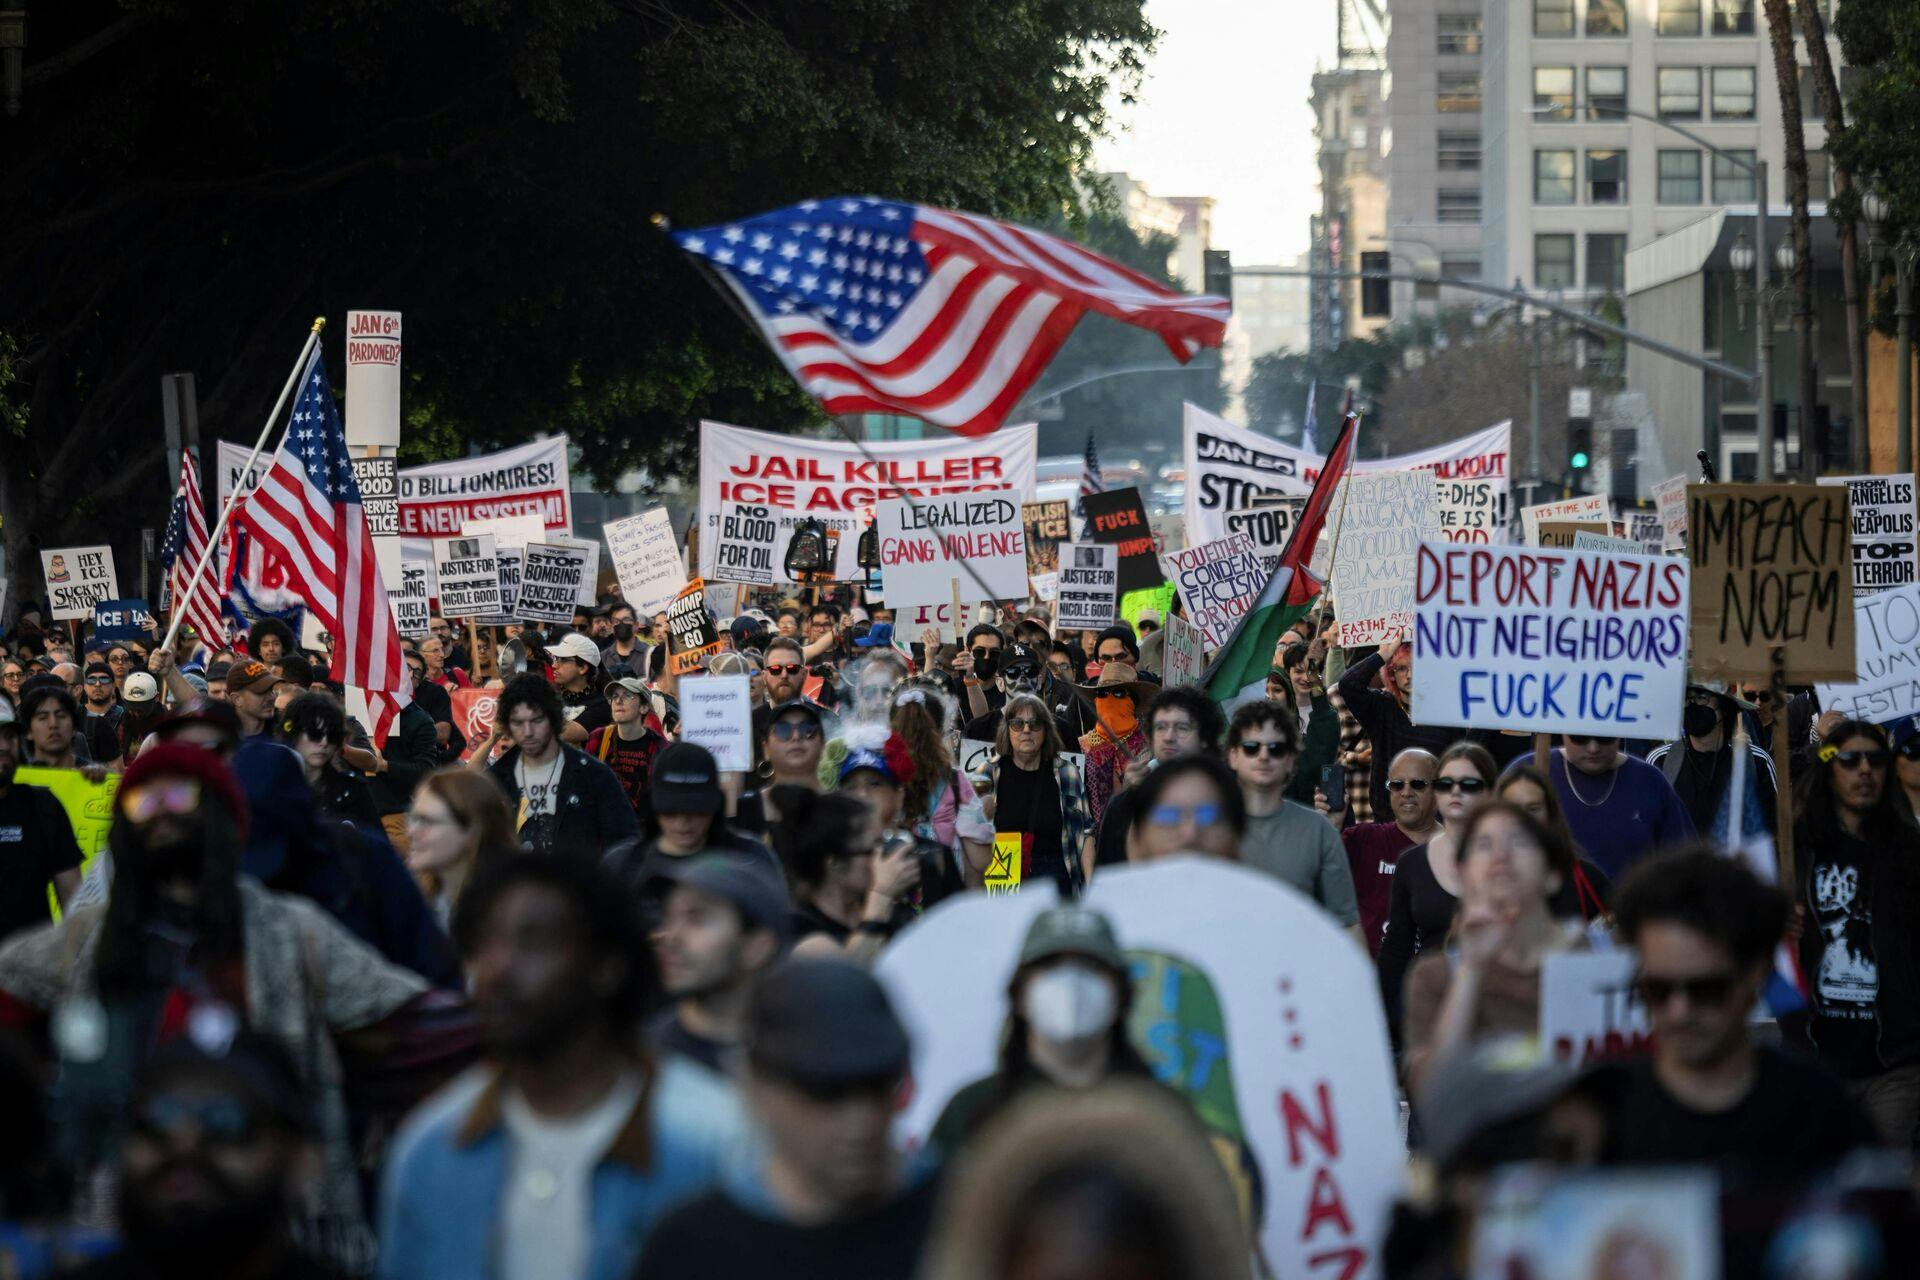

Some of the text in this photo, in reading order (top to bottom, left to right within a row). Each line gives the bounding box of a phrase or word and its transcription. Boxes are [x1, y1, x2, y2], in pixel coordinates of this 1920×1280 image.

[351, 314, 399, 335] JAN 6th
[349, 342, 401, 362] PARDONED?
[1198, 440, 1253, 465] JAN
[1256, 456, 1295, 475] 20
[1431, 453, 1506, 479] ALKOUT
[353, 461, 394, 480] RENEE
[418, 462, 555, 497] BILLIONAIRES!
[729, 455, 1003, 484] JAIL KILLER
[1846, 481, 1887, 489] FROM
[1851, 483, 1912, 505] ANGELES
[720, 482, 796, 510] ICE
[362, 500, 399, 515] SERVES
[735, 504, 769, 518] NO
[901, 499, 1016, 531] LEGALIZED
[1024, 504, 1067, 523] BOLISH
[1535, 500, 1601, 519] IT'S TIME WE
[1858, 508, 1878, 516] TO
[366, 515, 399, 531] TICE
[421, 505, 468, 533] NEW
[1038, 520, 1067, 538] ICE
[1095, 510, 1140, 533] FUCK
[1228, 510, 1289, 547] STOP
[1464, 511, 1486, 528] IS
[1851, 514, 1913, 535] NEAPOLIS
[723, 517, 776, 543] BLOOD
[1693, 494, 1849, 570] IMPEACH
[881, 531, 1024, 565] GANG VIOLENCE
[1117, 537, 1155, 557] UMP!
[1577, 535, 1609, 550] NORTH
[1852, 543, 1914, 560] TOP
[78, 552, 103, 567] HEY
[527, 554, 584, 567] STOP
[719, 544, 773, 570] FOR OIL
[1170, 547, 1206, 571] YOU
[81, 566, 110, 580] ICE.
[440, 559, 495, 576] JUSTICE FOR
[524, 564, 580, 585] BOMBING
[1061, 569, 1115, 585] JUSTICE FOR
[1180, 552, 1261, 590] CONDEM
[1416, 543, 1686, 612] DEPORT NAZIS
[1854, 561, 1914, 585] TERROR
[54, 582, 111, 606] SUCK MY
[440, 579, 497, 591] RENEE
[521, 584, 576, 603] VENEZUELA
[1185, 568, 1267, 612] FACISM
[442, 590, 498, 606] NICOLE GOOD
[519, 599, 574, 613] NOW!
[667, 591, 703, 619] TRUMP
[1060, 591, 1114, 603] RENEE
[398, 602, 427, 617] ZUELA
[1059, 602, 1113, 617] NICOLE GOOD
[1194, 606, 1219, 628] OR
[1719, 569, 1840, 649] NOEM
[97, 612, 122, 627] ICE
[670, 610, 705, 637] MUST
[684, 630, 704, 650] GO
[1202, 628, 1219, 647] A
[1416, 611, 1488, 659] NOT
[1014, 645, 1025, 656] LA
[1459, 671, 1651, 723] FUCK ICE.
